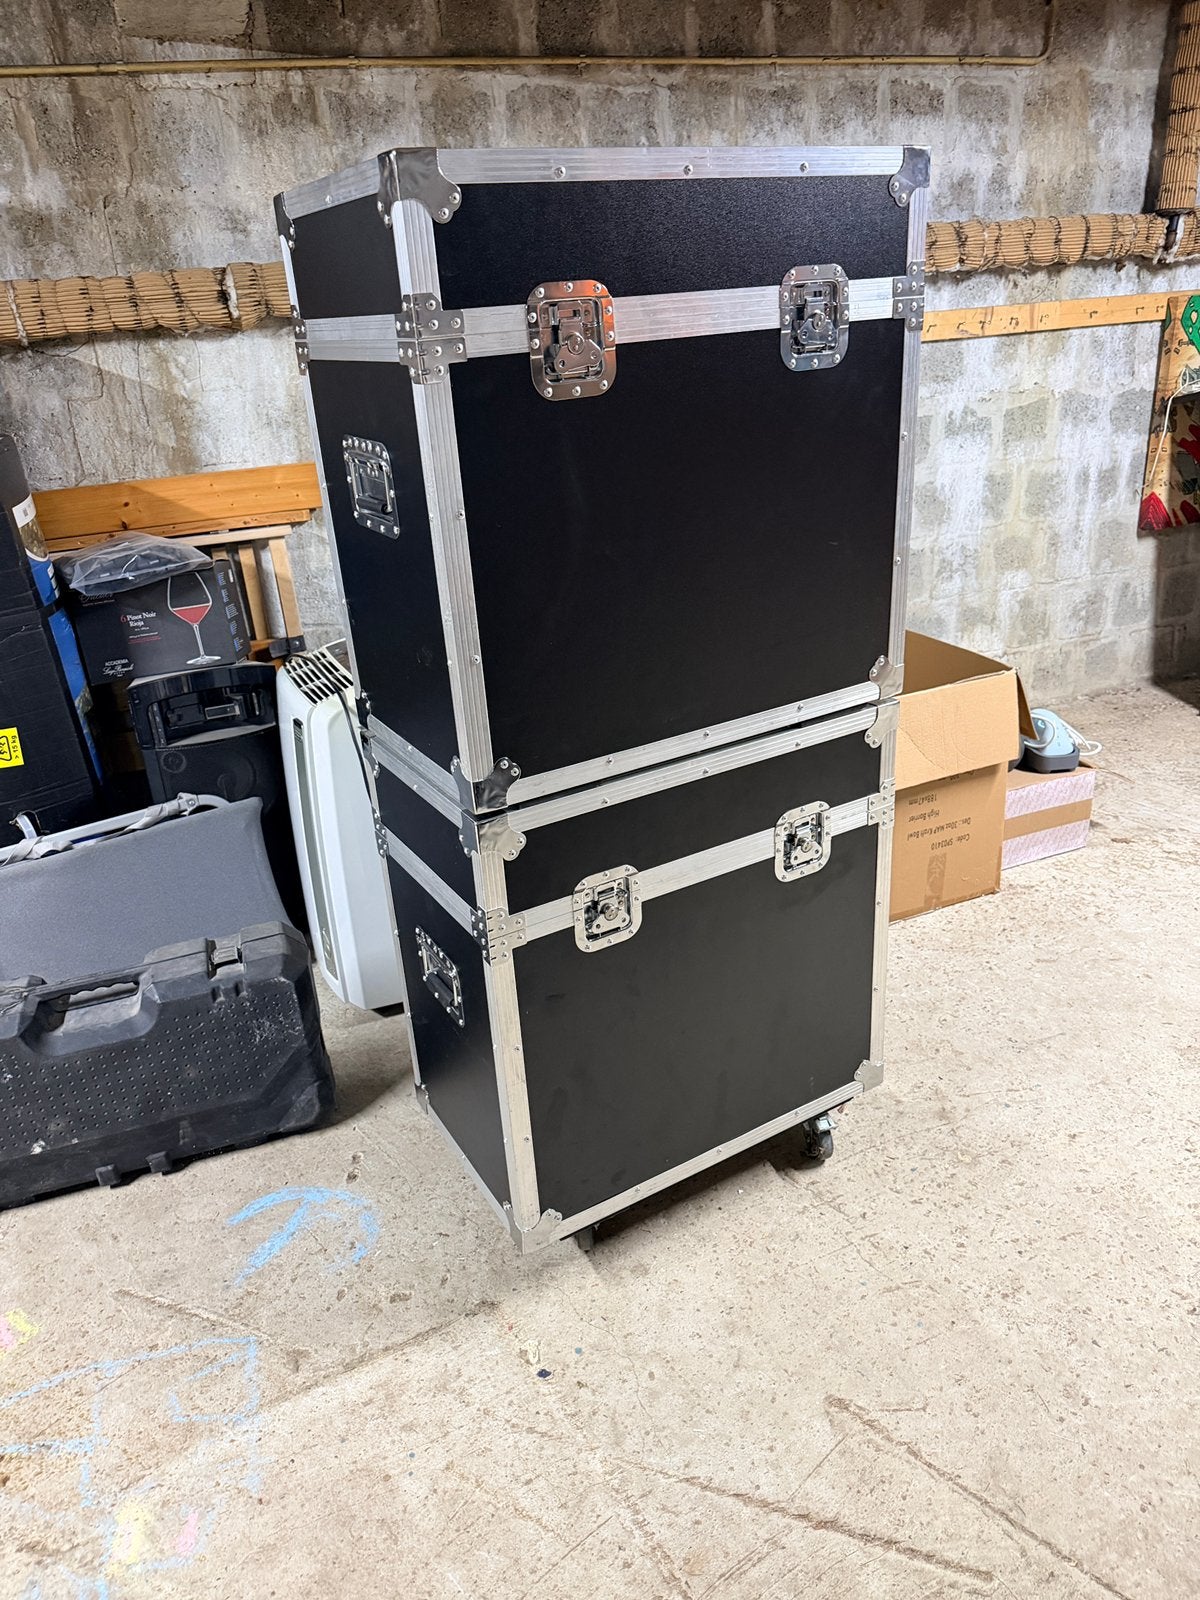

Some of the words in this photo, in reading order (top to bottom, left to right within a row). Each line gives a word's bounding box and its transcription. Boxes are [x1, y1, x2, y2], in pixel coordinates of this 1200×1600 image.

[142, 611, 157, 619] Noir
[11, 735, 17, 744] kg
[907, 830, 920, 841] Bowl
